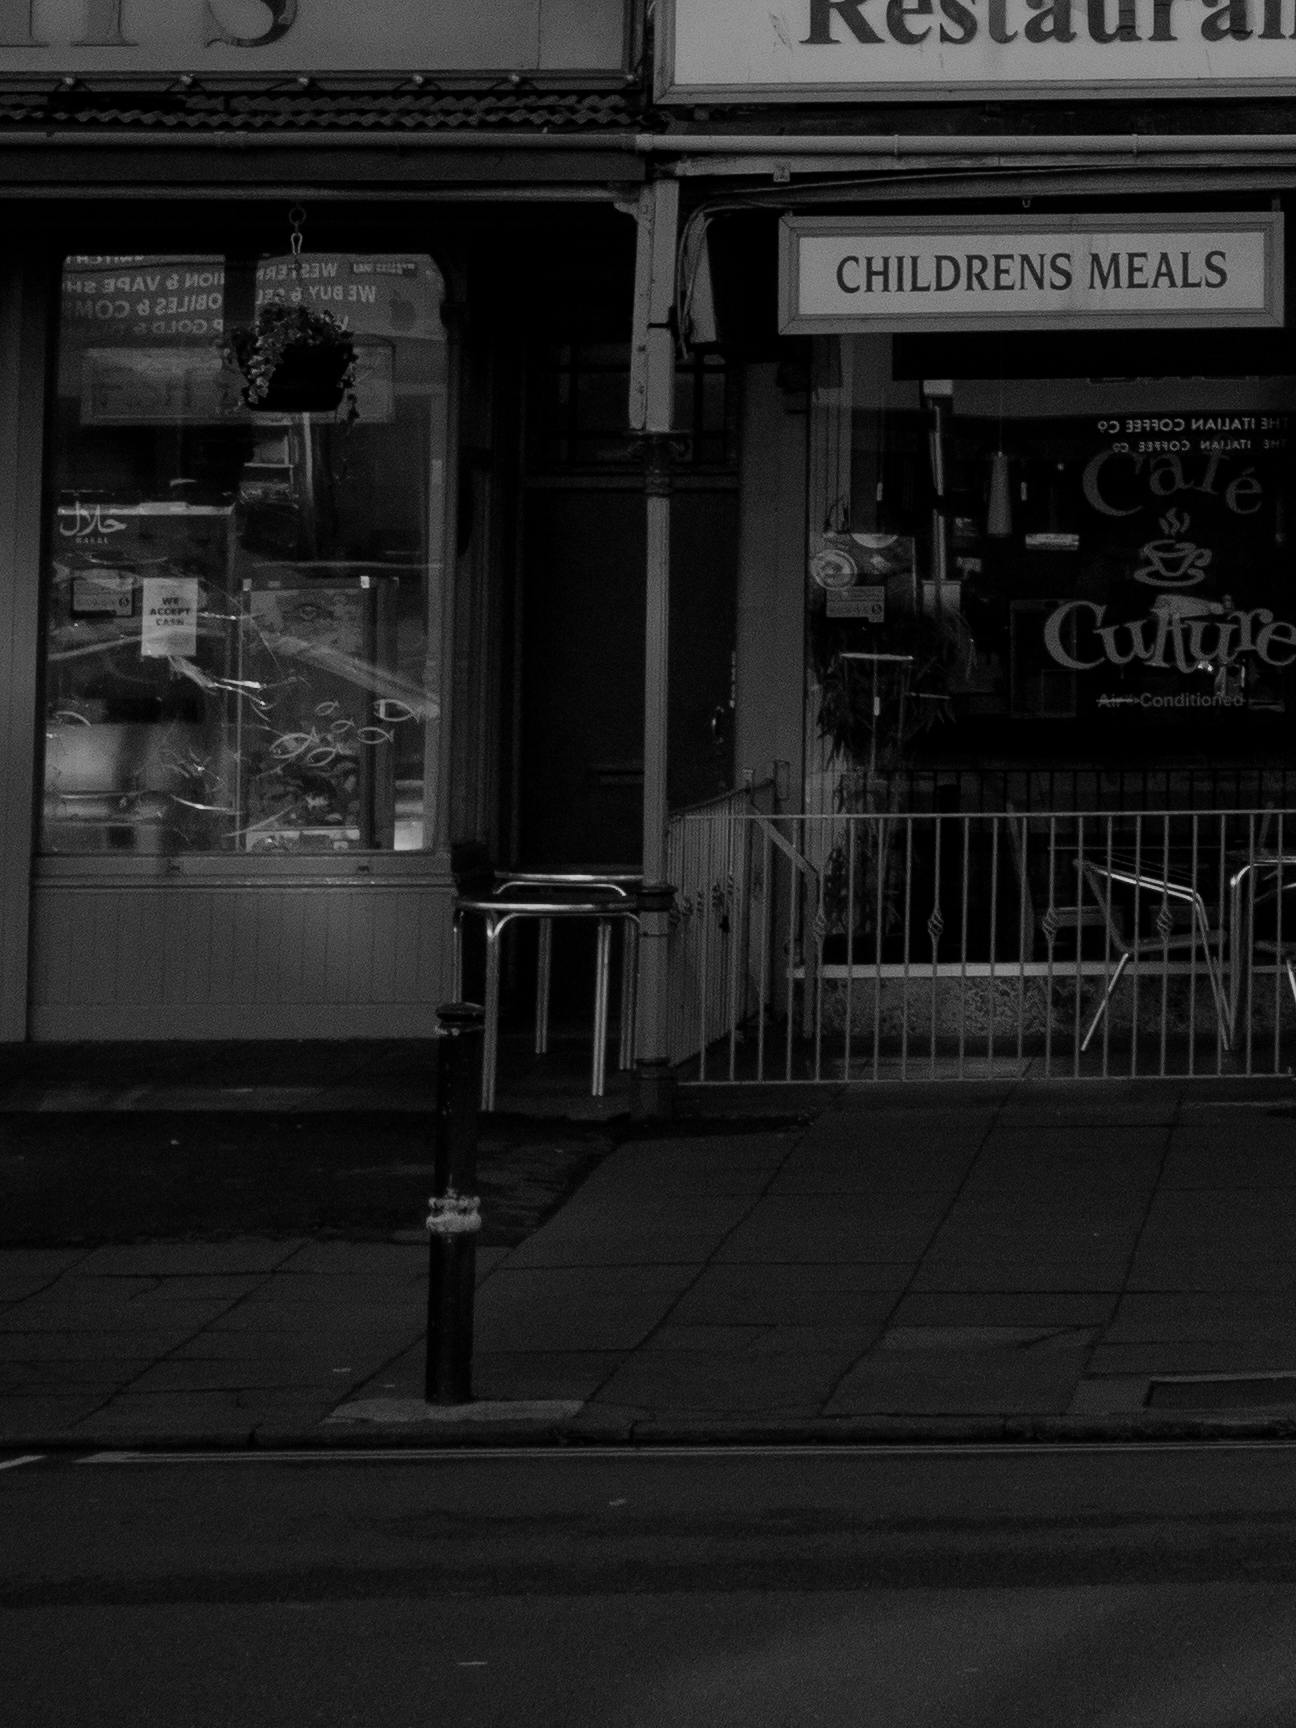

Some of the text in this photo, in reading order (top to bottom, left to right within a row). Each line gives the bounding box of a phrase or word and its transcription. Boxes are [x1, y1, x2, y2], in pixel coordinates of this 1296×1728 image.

[836, 250, 1229, 294] CHILDRENS MEALS
[1082, 433, 1264, 517] Café
[59, 500, 128, 537] حلال
[150, 607, 191, 617] ACCEPT
[1139, 692, 1244, 709] Conditioned
